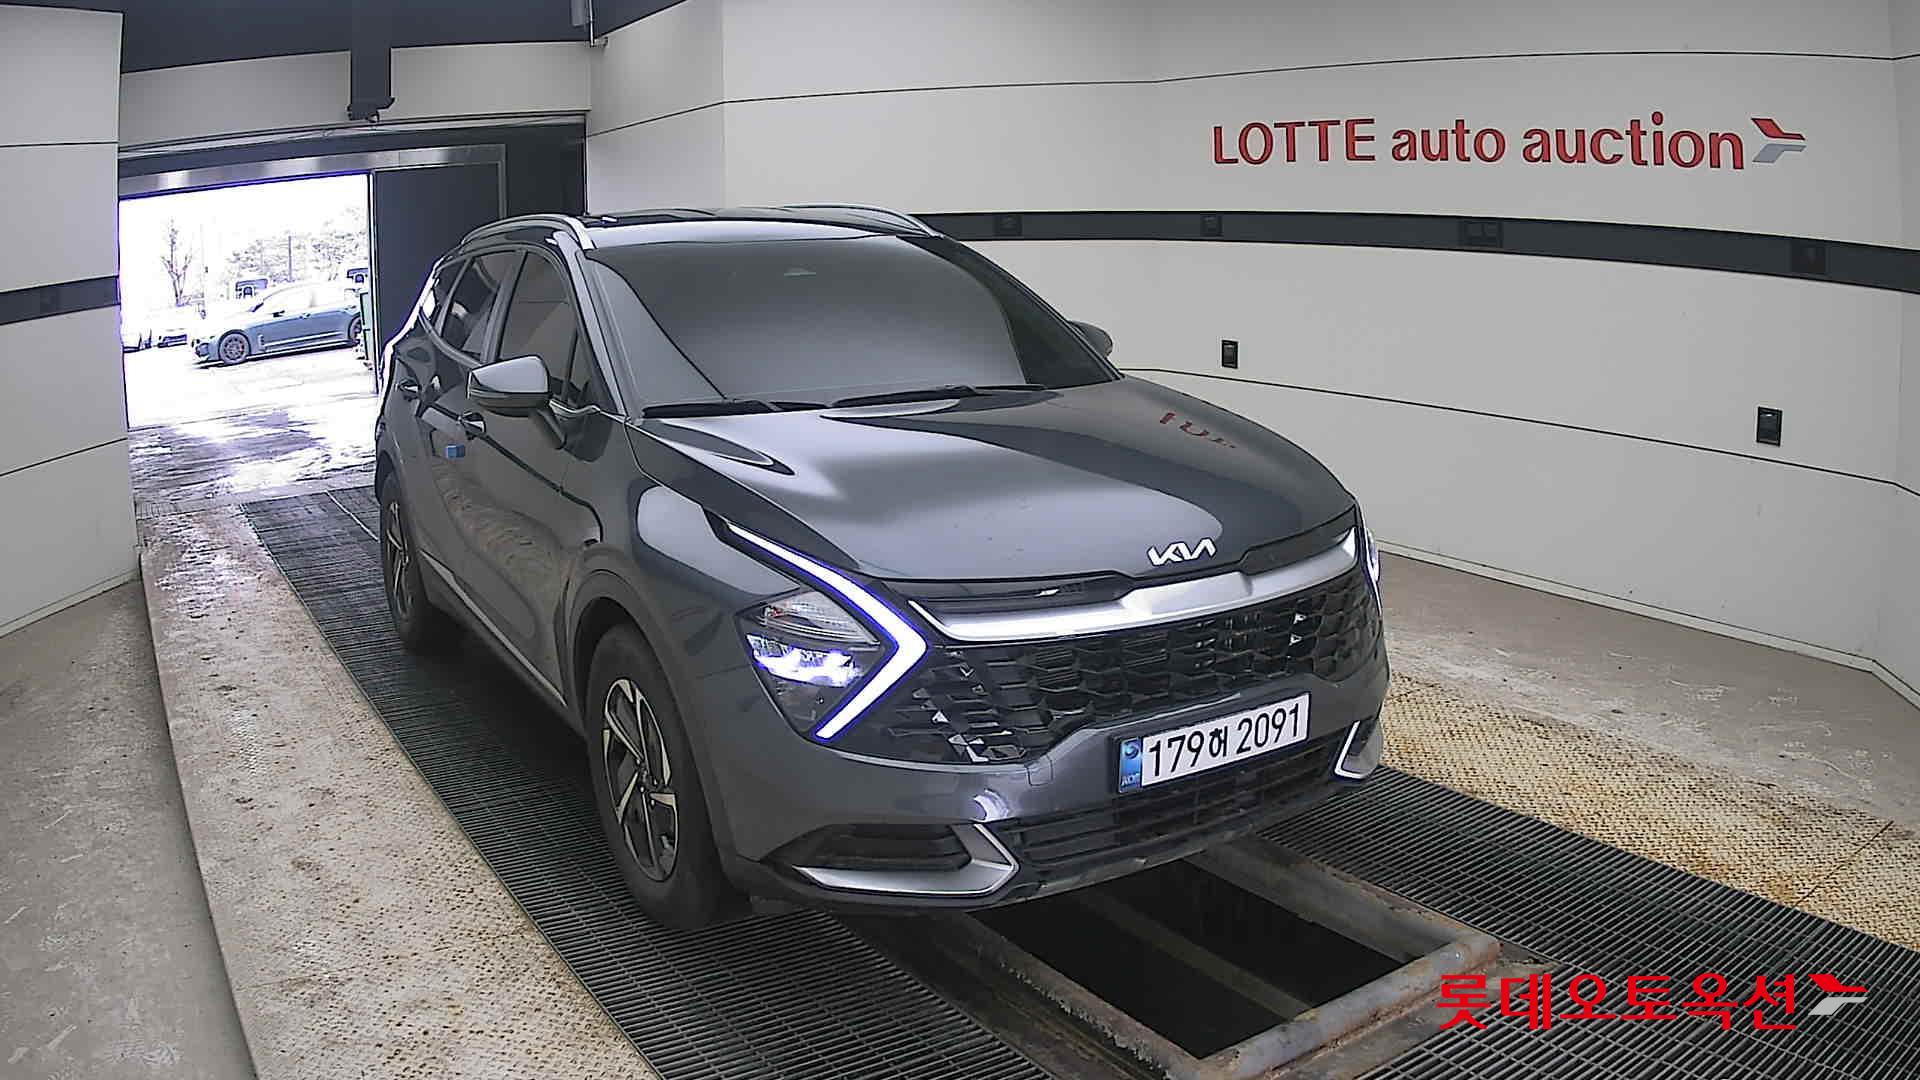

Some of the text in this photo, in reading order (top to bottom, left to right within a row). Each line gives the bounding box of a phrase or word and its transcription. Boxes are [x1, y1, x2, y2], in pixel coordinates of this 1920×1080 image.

[1213, 111, 1744, 170] LOTTE auto auction
[1236, 702, 1300, 755] 2091
